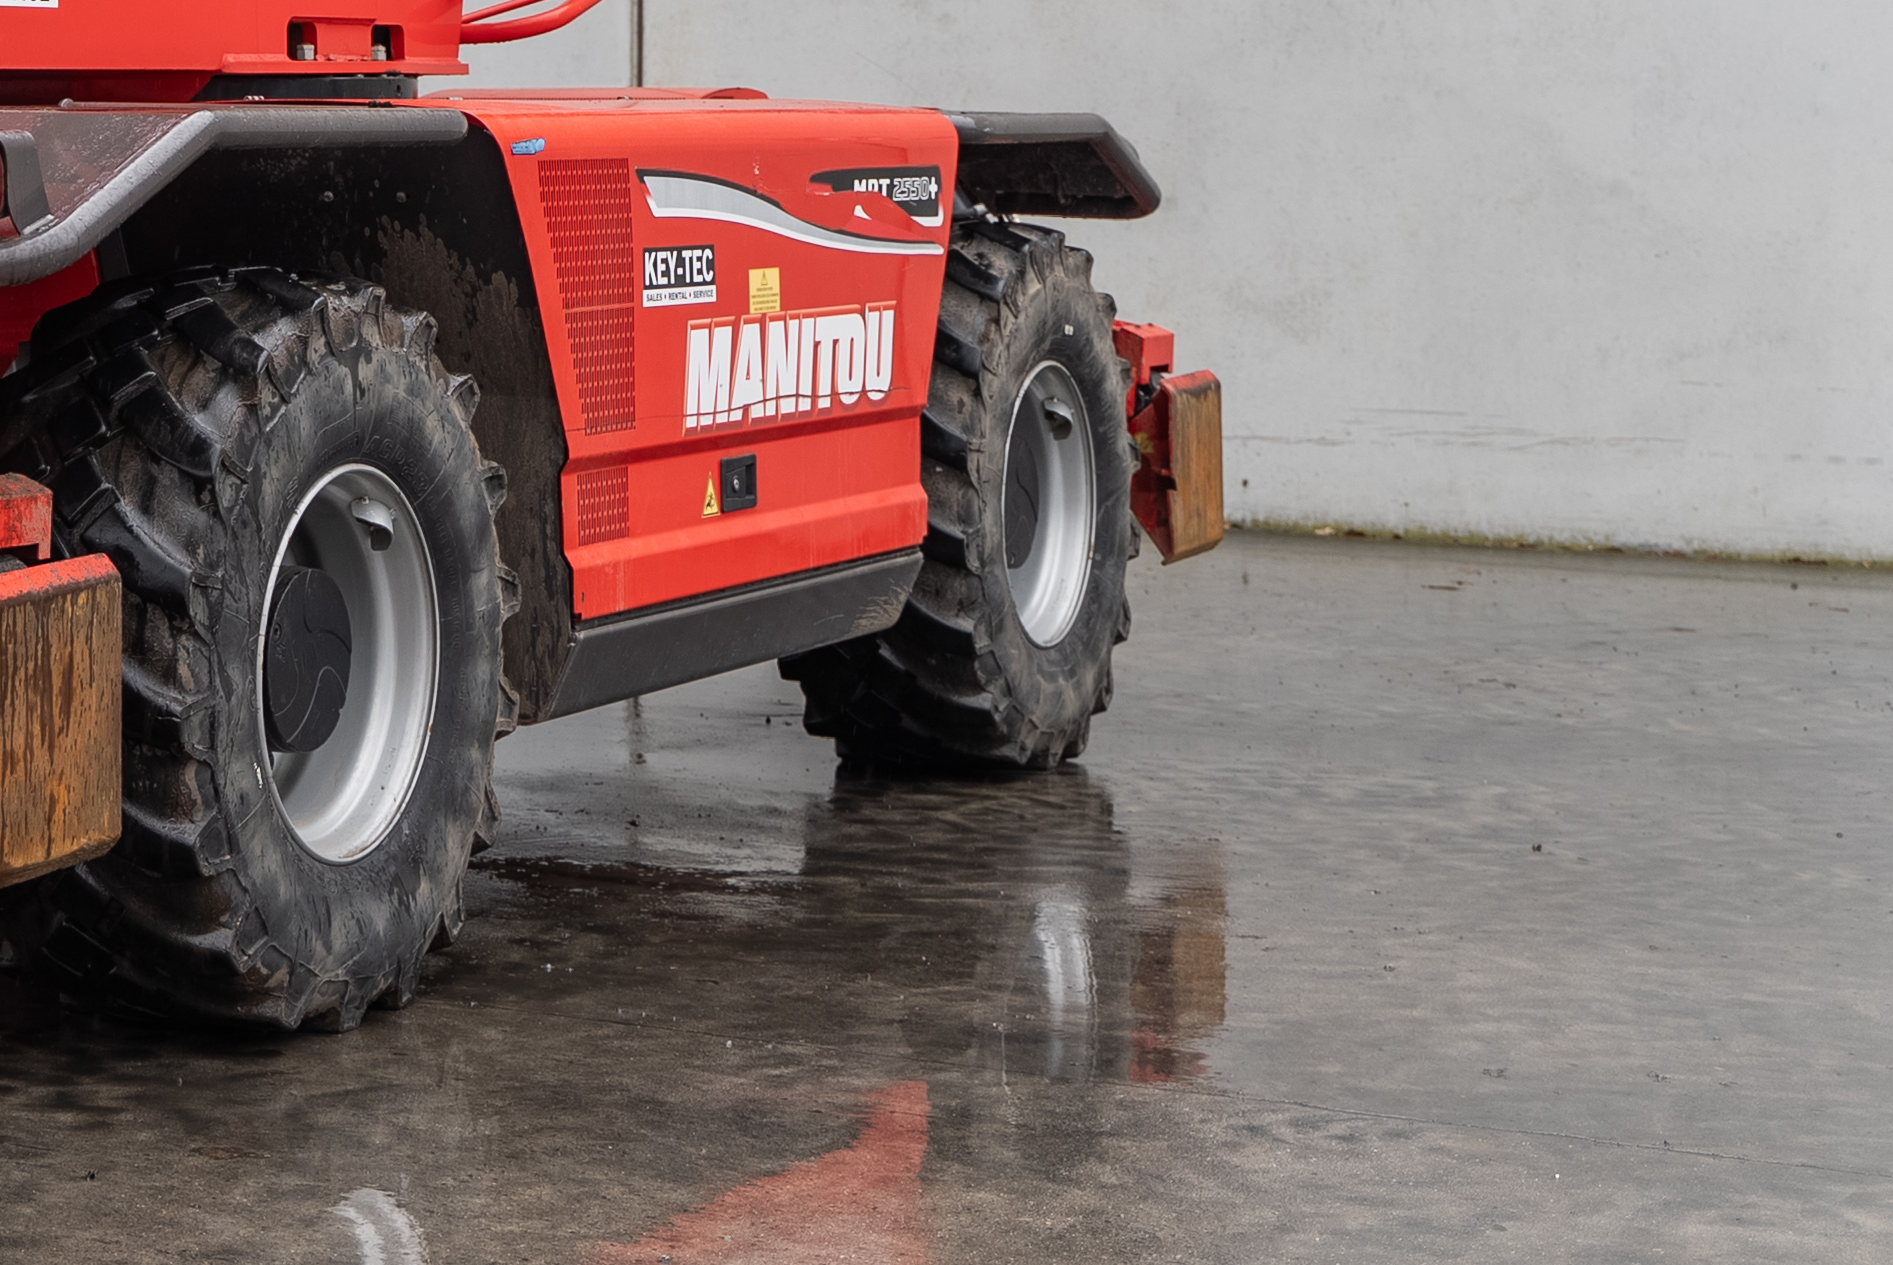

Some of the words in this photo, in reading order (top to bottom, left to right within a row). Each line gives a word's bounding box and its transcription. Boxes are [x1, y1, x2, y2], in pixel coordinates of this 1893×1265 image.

[644, 248, 714, 286] KEY-TEC
[646, 293, 663, 302] SALES
[668, 291, 687, 301] RENTAL
[693, 289, 714, 299] SERVICE
[685, 307, 895, 429] MANITOU
